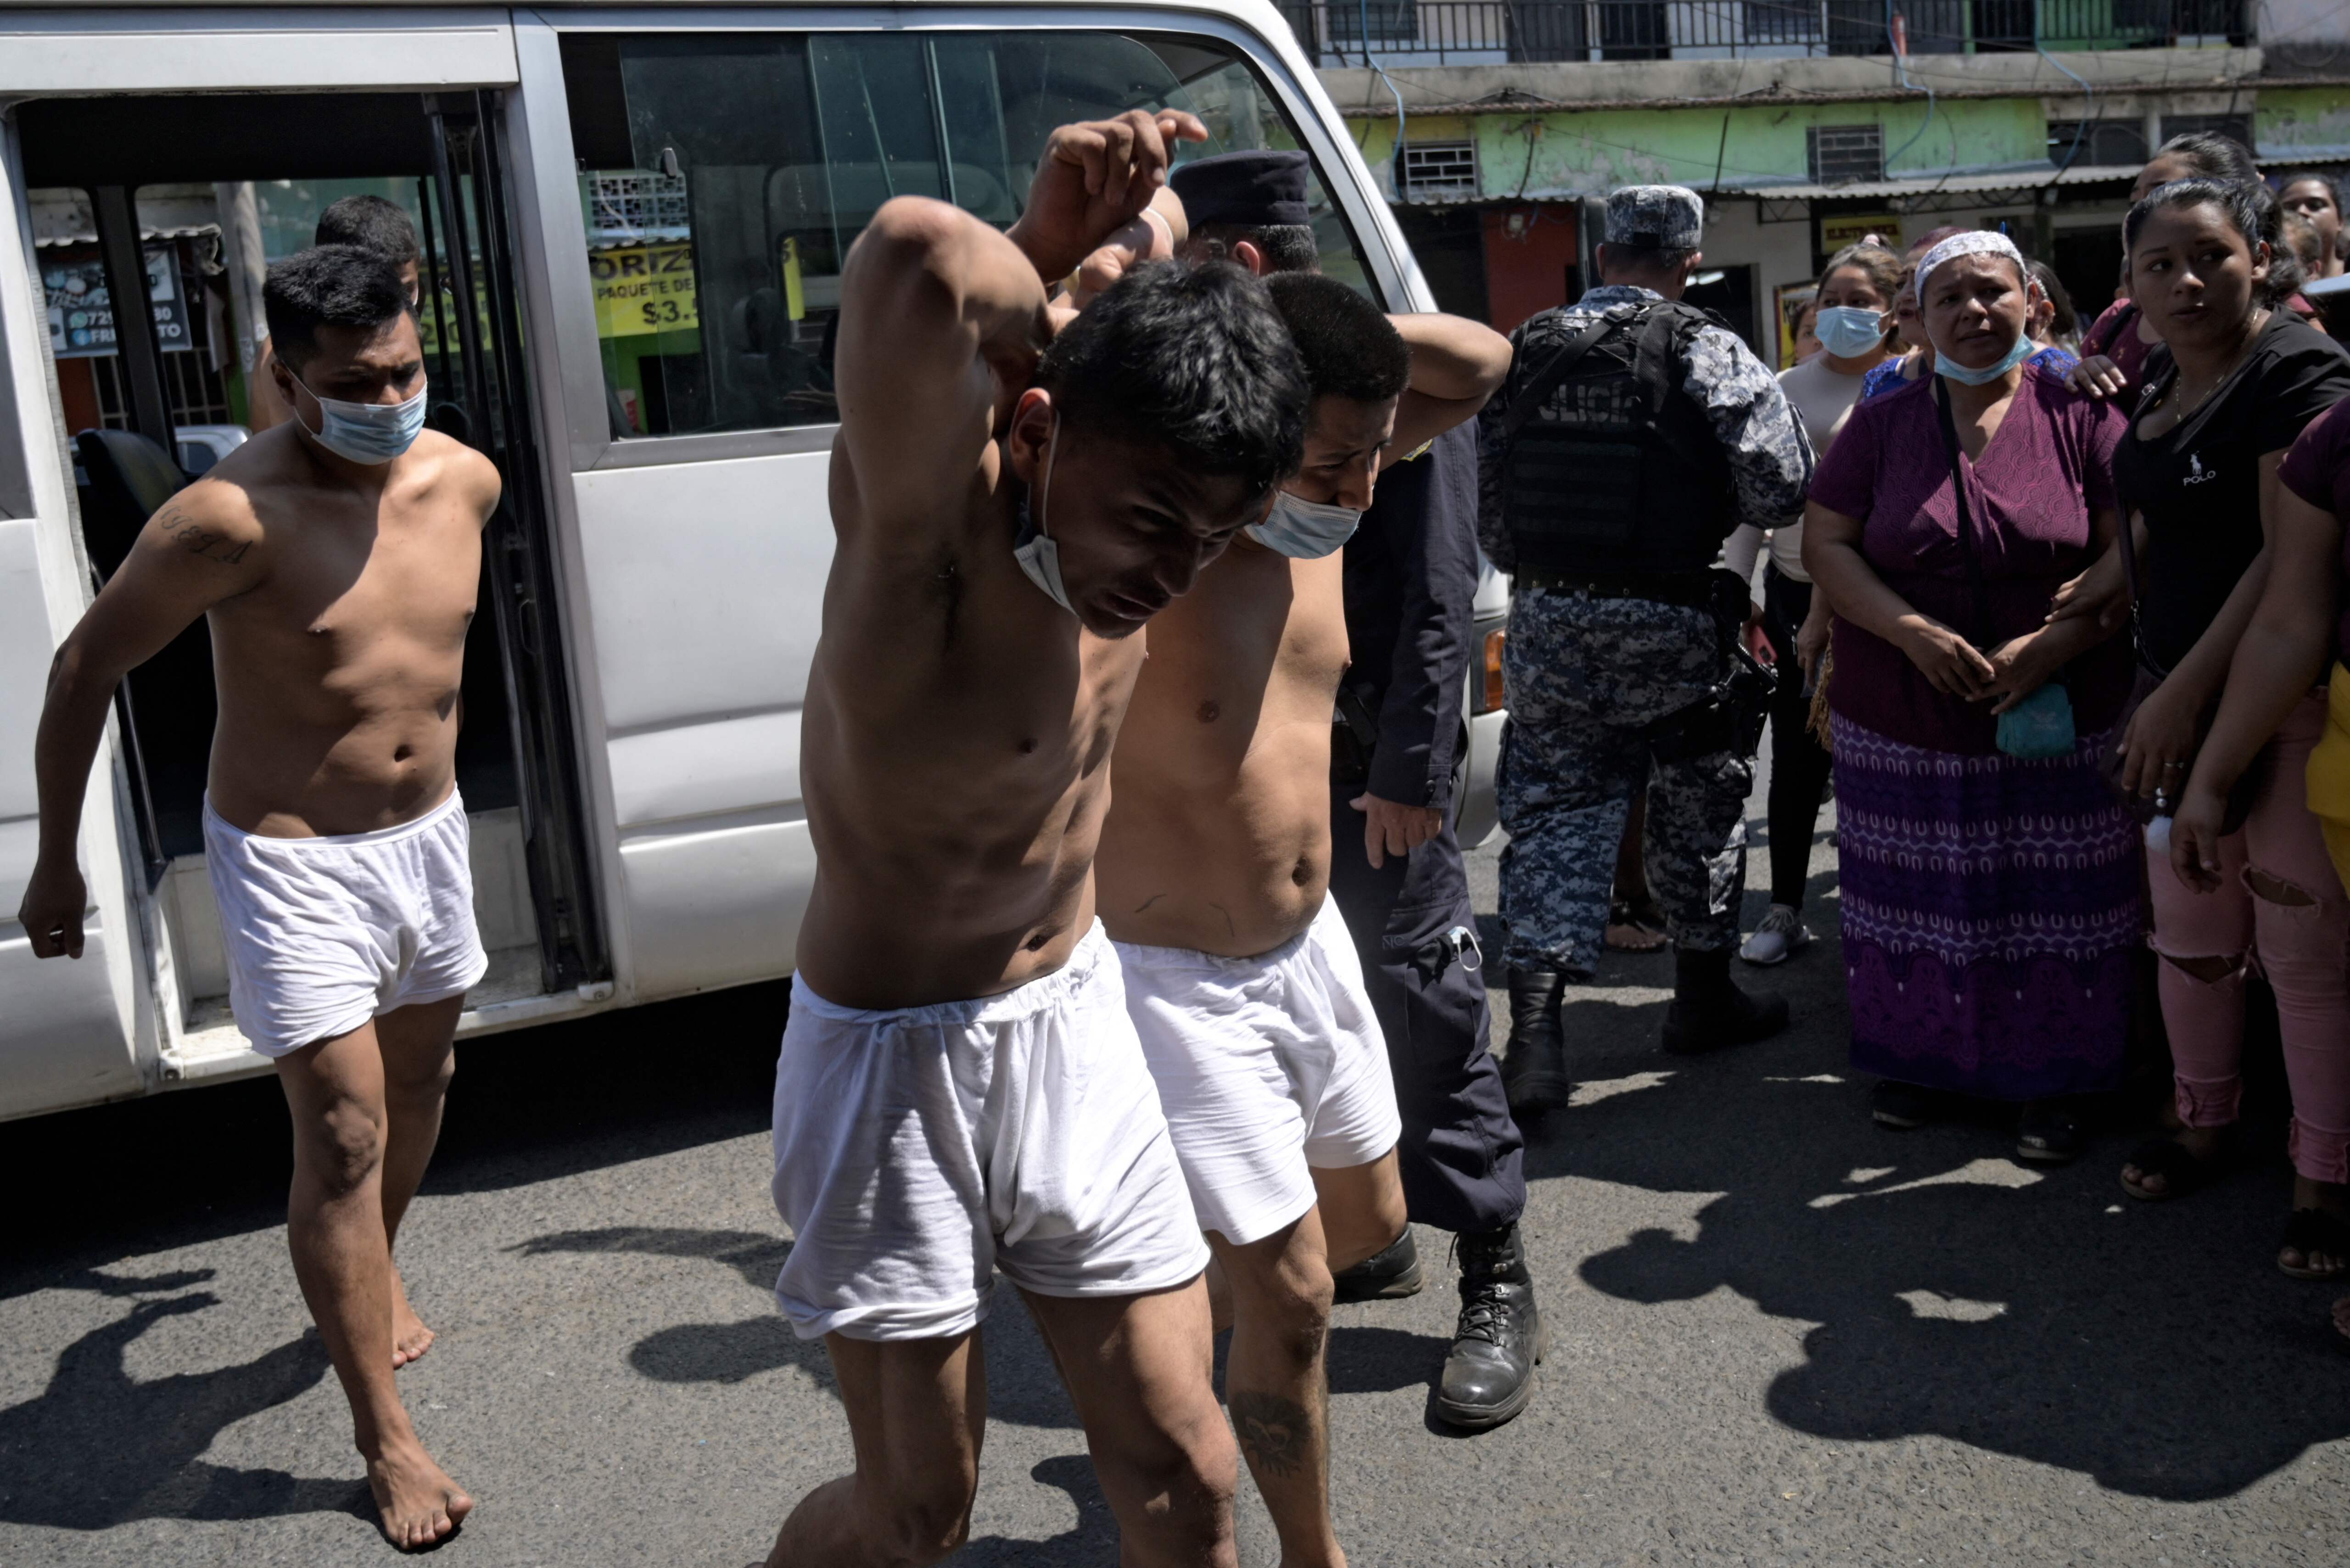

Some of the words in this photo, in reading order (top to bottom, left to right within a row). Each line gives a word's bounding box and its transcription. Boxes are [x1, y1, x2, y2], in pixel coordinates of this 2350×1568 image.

[598, 281, 669, 300] PAQUETE
[673, 278, 693, 292] DE
[2183, 470, 2216, 486] POLO
